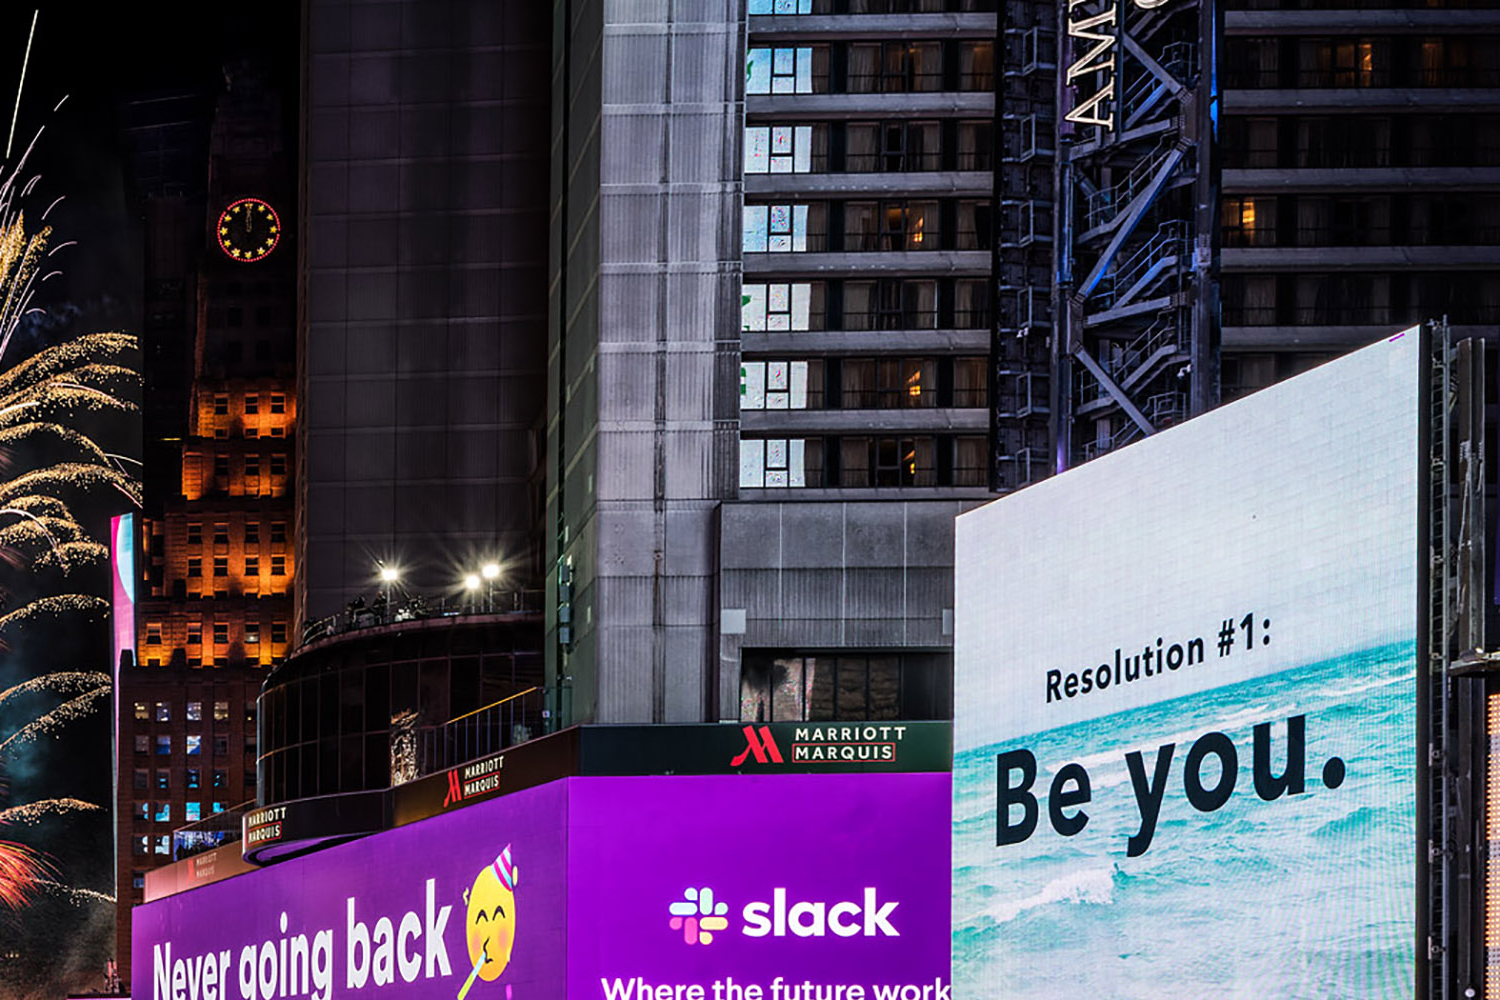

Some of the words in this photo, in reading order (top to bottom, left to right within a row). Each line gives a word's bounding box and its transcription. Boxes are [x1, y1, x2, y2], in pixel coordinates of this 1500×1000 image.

[1045, 638, 1205, 704] Resolution
[1217, 612, 1273, 659] #1:
[795, 726, 907, 743] MARRIOTT
[463, 756, 504, 779] MARRIOTT
[794, 745, 893, 762] MARQUIS
[464, 775, 500, 797] MARQUIS
[996, 747, 1092, 848] Be
[1124, 713, 1347, 859] you.
[741, 886, 901, 938] slack
[346, 878, 453, 989] back
